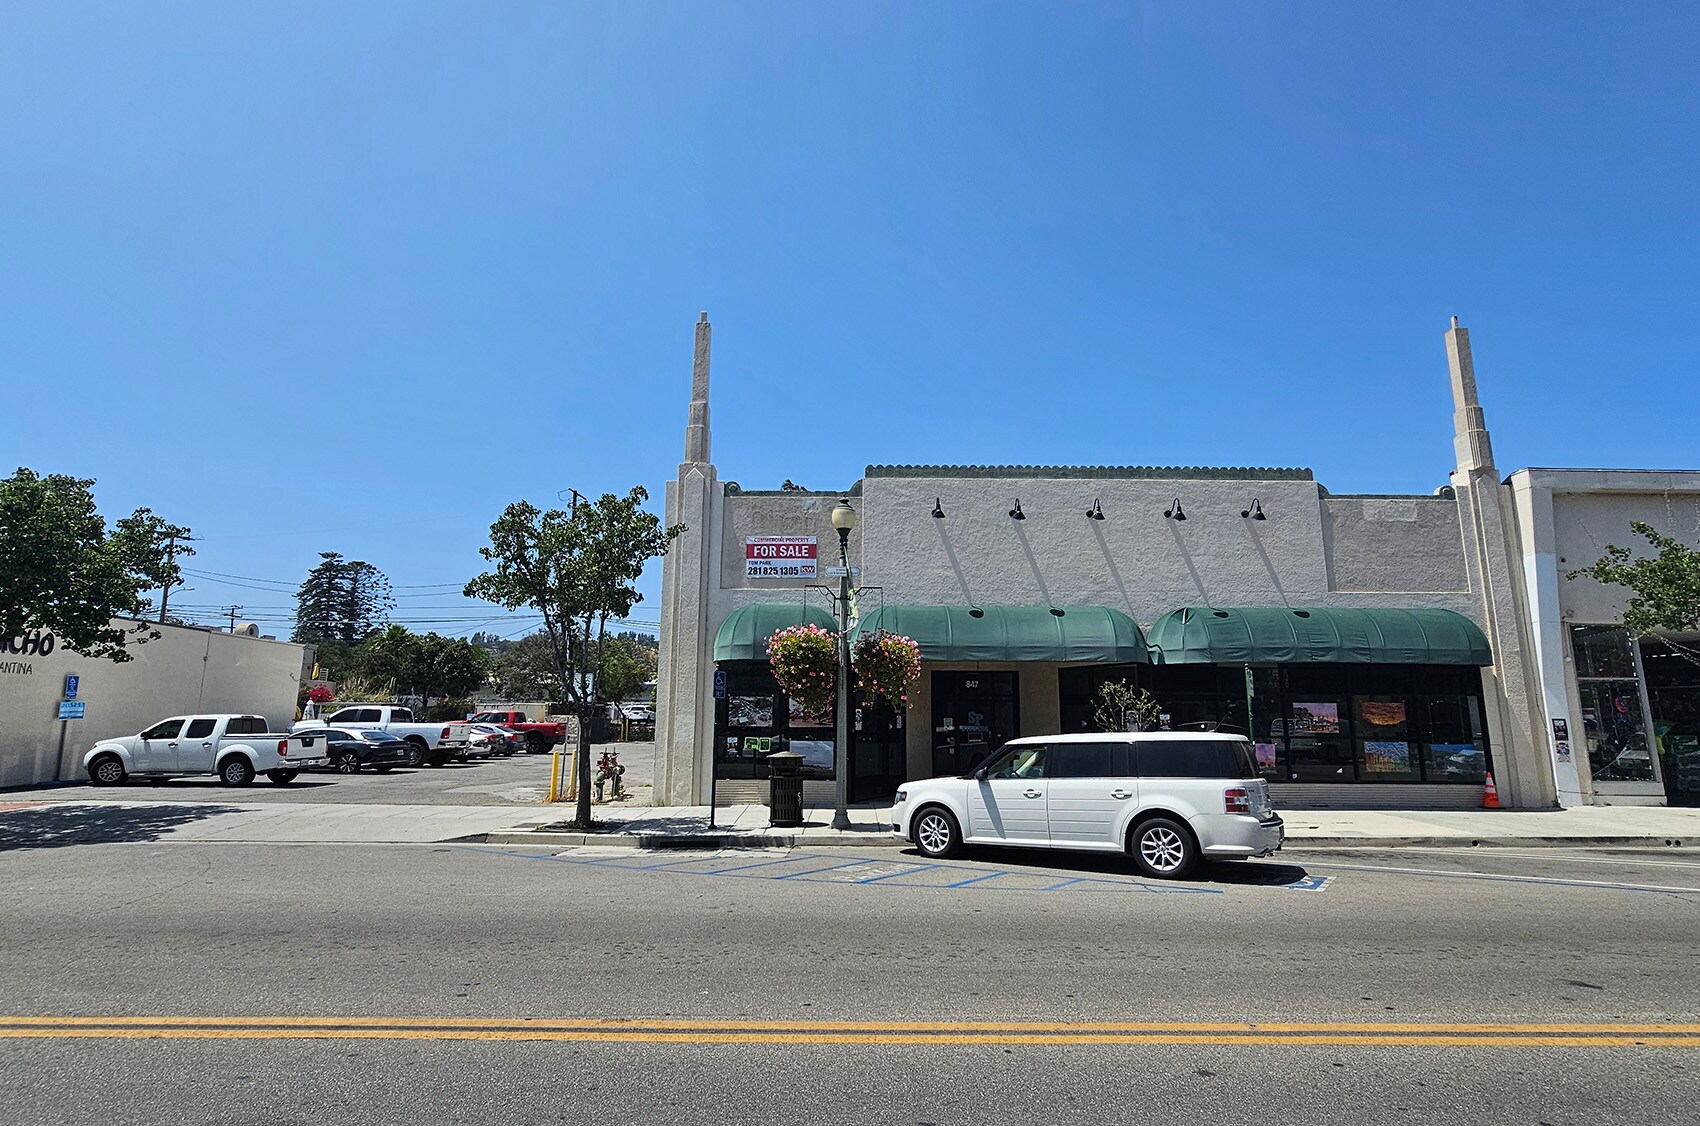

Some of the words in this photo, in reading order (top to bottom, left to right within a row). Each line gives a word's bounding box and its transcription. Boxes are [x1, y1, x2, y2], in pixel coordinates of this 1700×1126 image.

[754, 546, 776, 556] FOR
[779, 546, 809, 556] SALE
[748, 567, 762, 575] 281
[764, 567, 778, 575] 825
[780, 567, 798, 575] 1305
